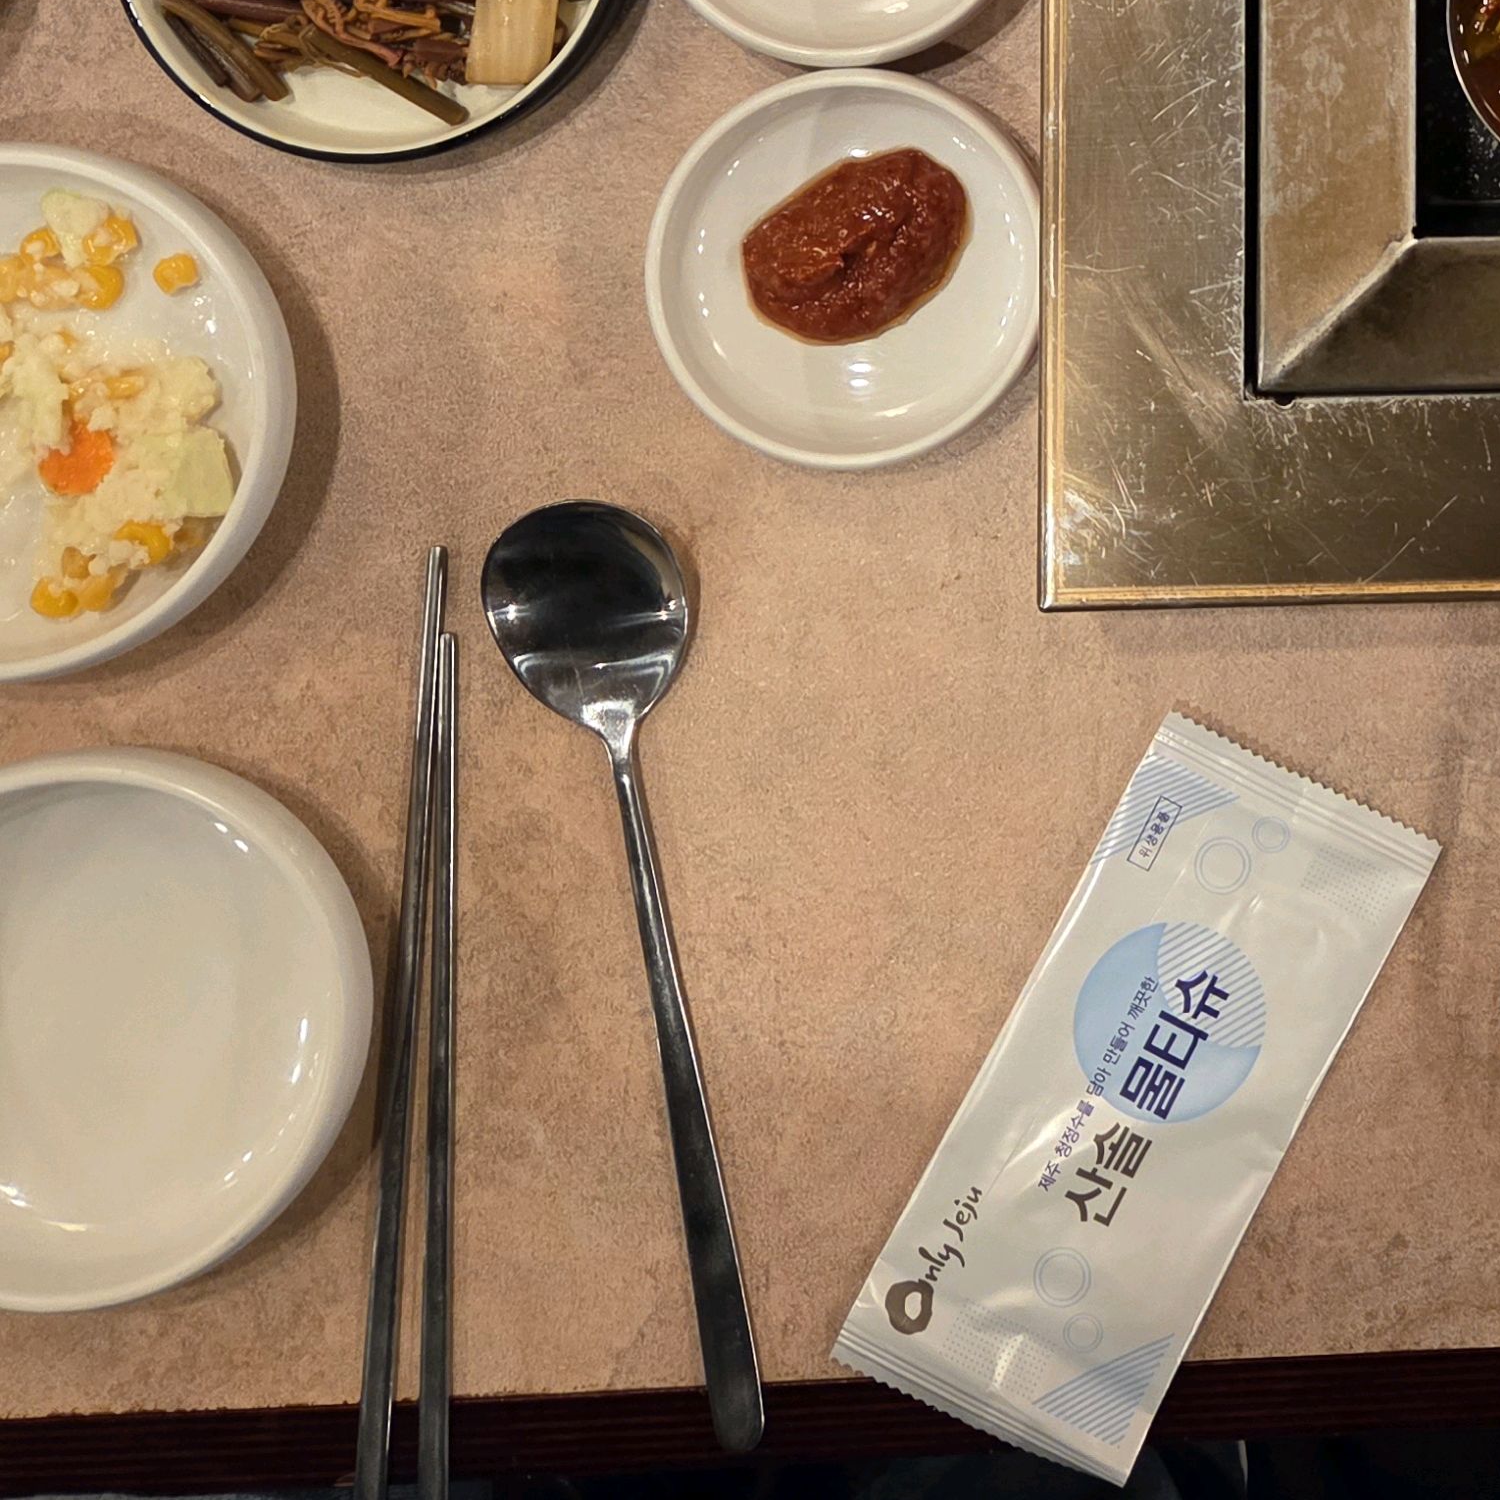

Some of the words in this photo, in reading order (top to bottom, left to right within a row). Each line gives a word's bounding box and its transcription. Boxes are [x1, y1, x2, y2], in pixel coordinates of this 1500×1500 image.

[1138, 812, 1170, 858] 위생용품
[1038, 1160, 1062, 1192] 제주
[1055, 1100, 1095, 1157] 청정수를
[1086, 1067, 1112, 1097] 담아
[1103, 1022, 1135, 1065] 만들어
[1128, 976, 1159, 1020] 깨끗한
[1064, 1122, 1152, 1227] 산솔
[1119, 970, 1230, 1120] 물티슈
[885, 1244, 965, 1335] Only
[942, 1186, 982, 1242] Jeju
